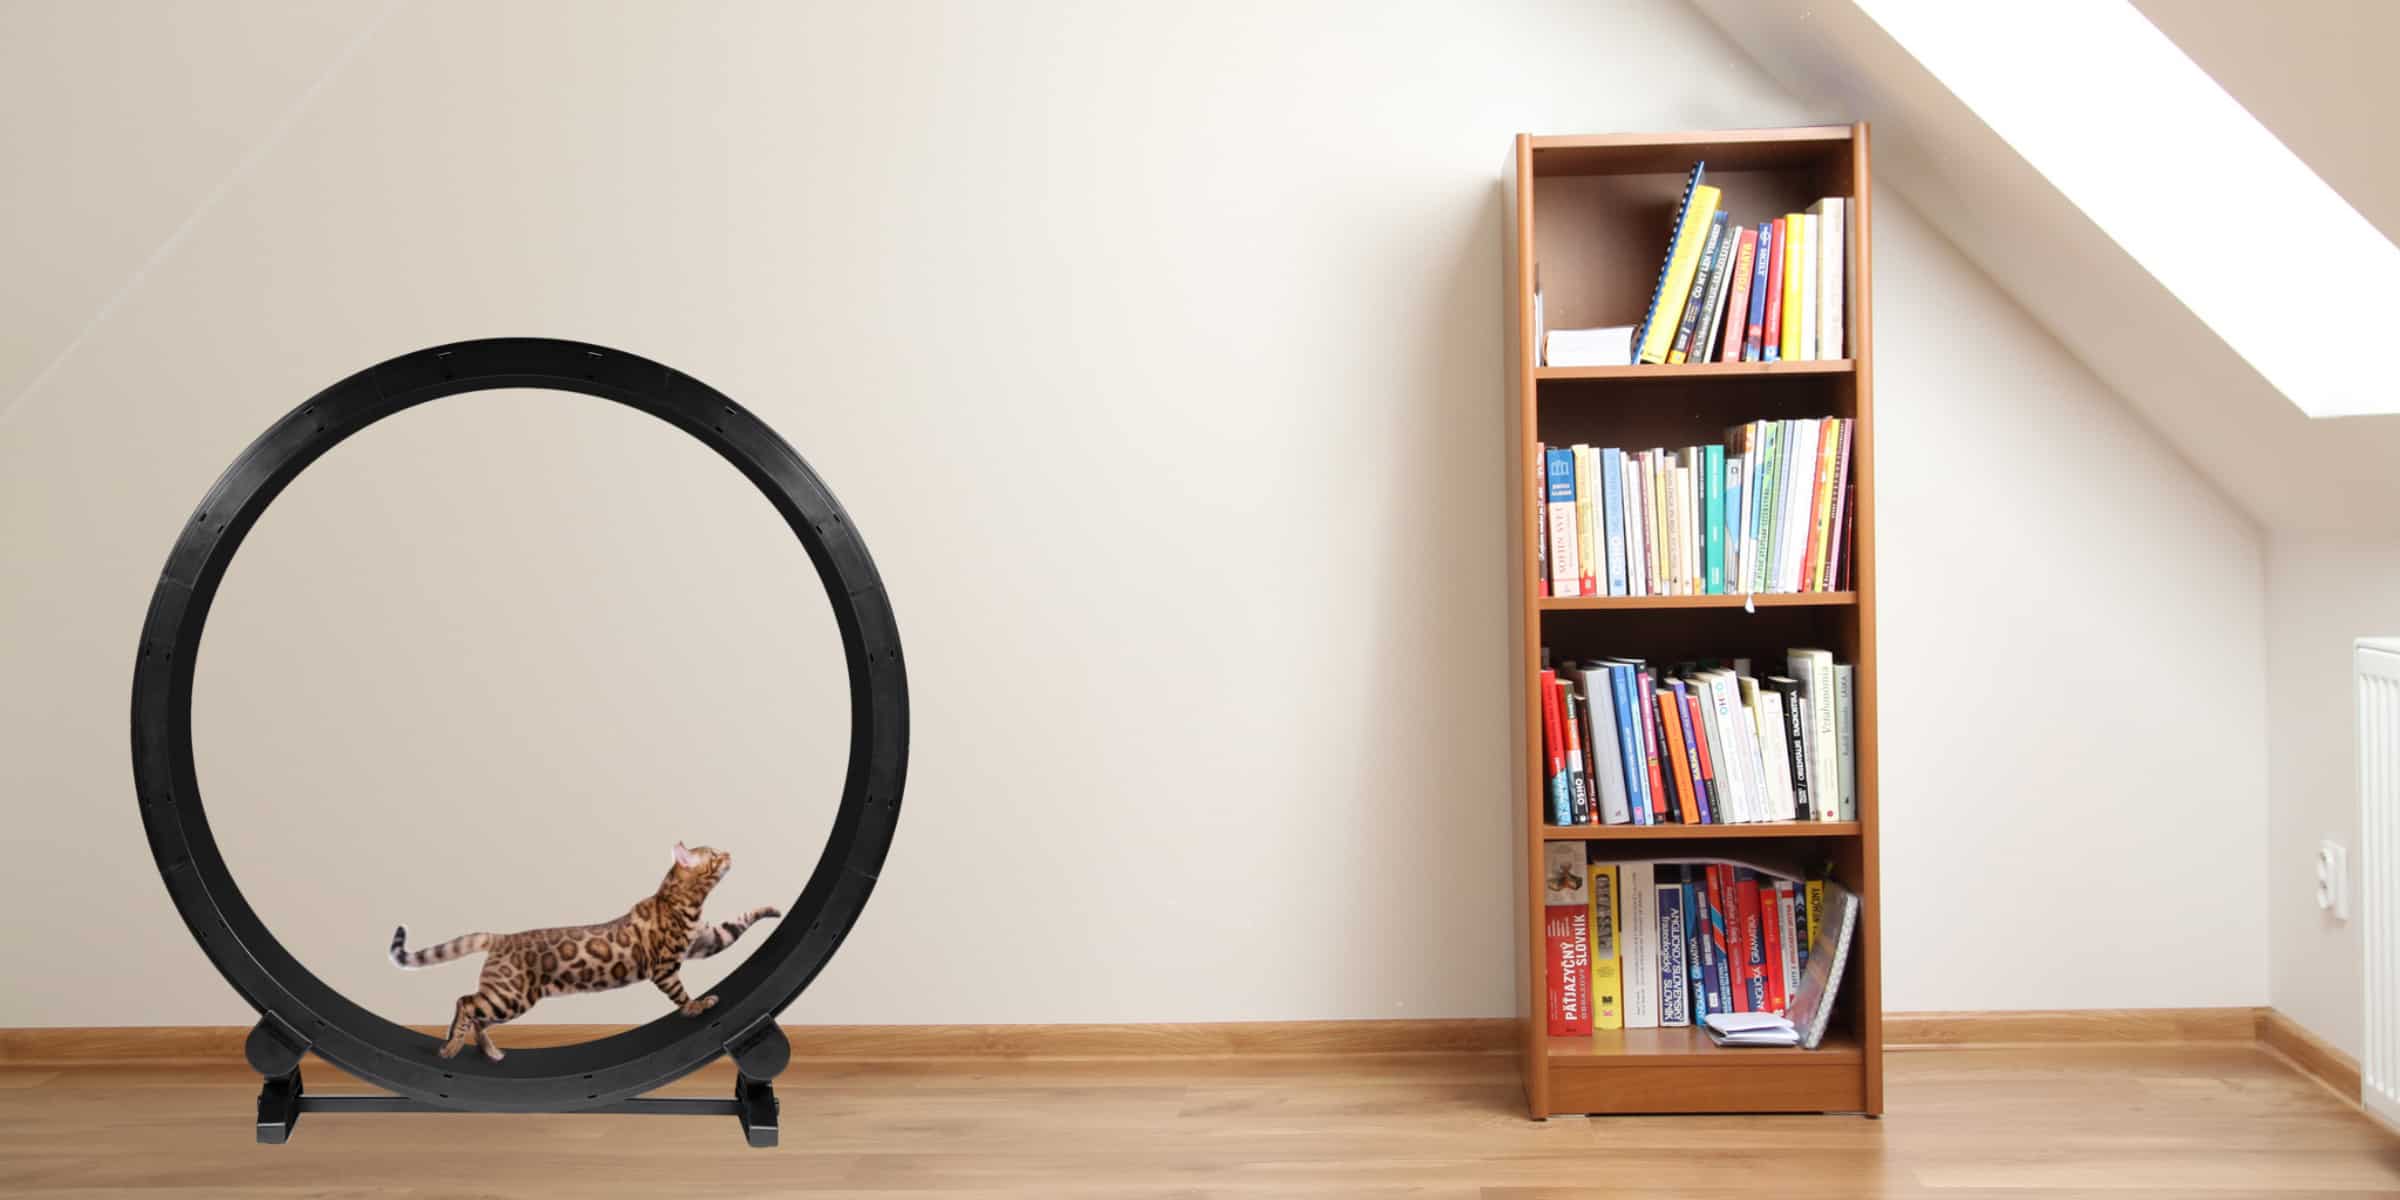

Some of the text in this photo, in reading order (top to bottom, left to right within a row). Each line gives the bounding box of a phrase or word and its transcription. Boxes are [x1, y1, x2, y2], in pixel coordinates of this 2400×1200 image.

[1690, 748, 1700, 780] KARMA
[1575, 778, 1585, 805] OSHO
[1572, 914, 1588, 966] SLOVNÍK
[1747, 914, 1761, 963] GRAMATIKA
[1663, 979, 1673, 1020] SLOVNÍK
